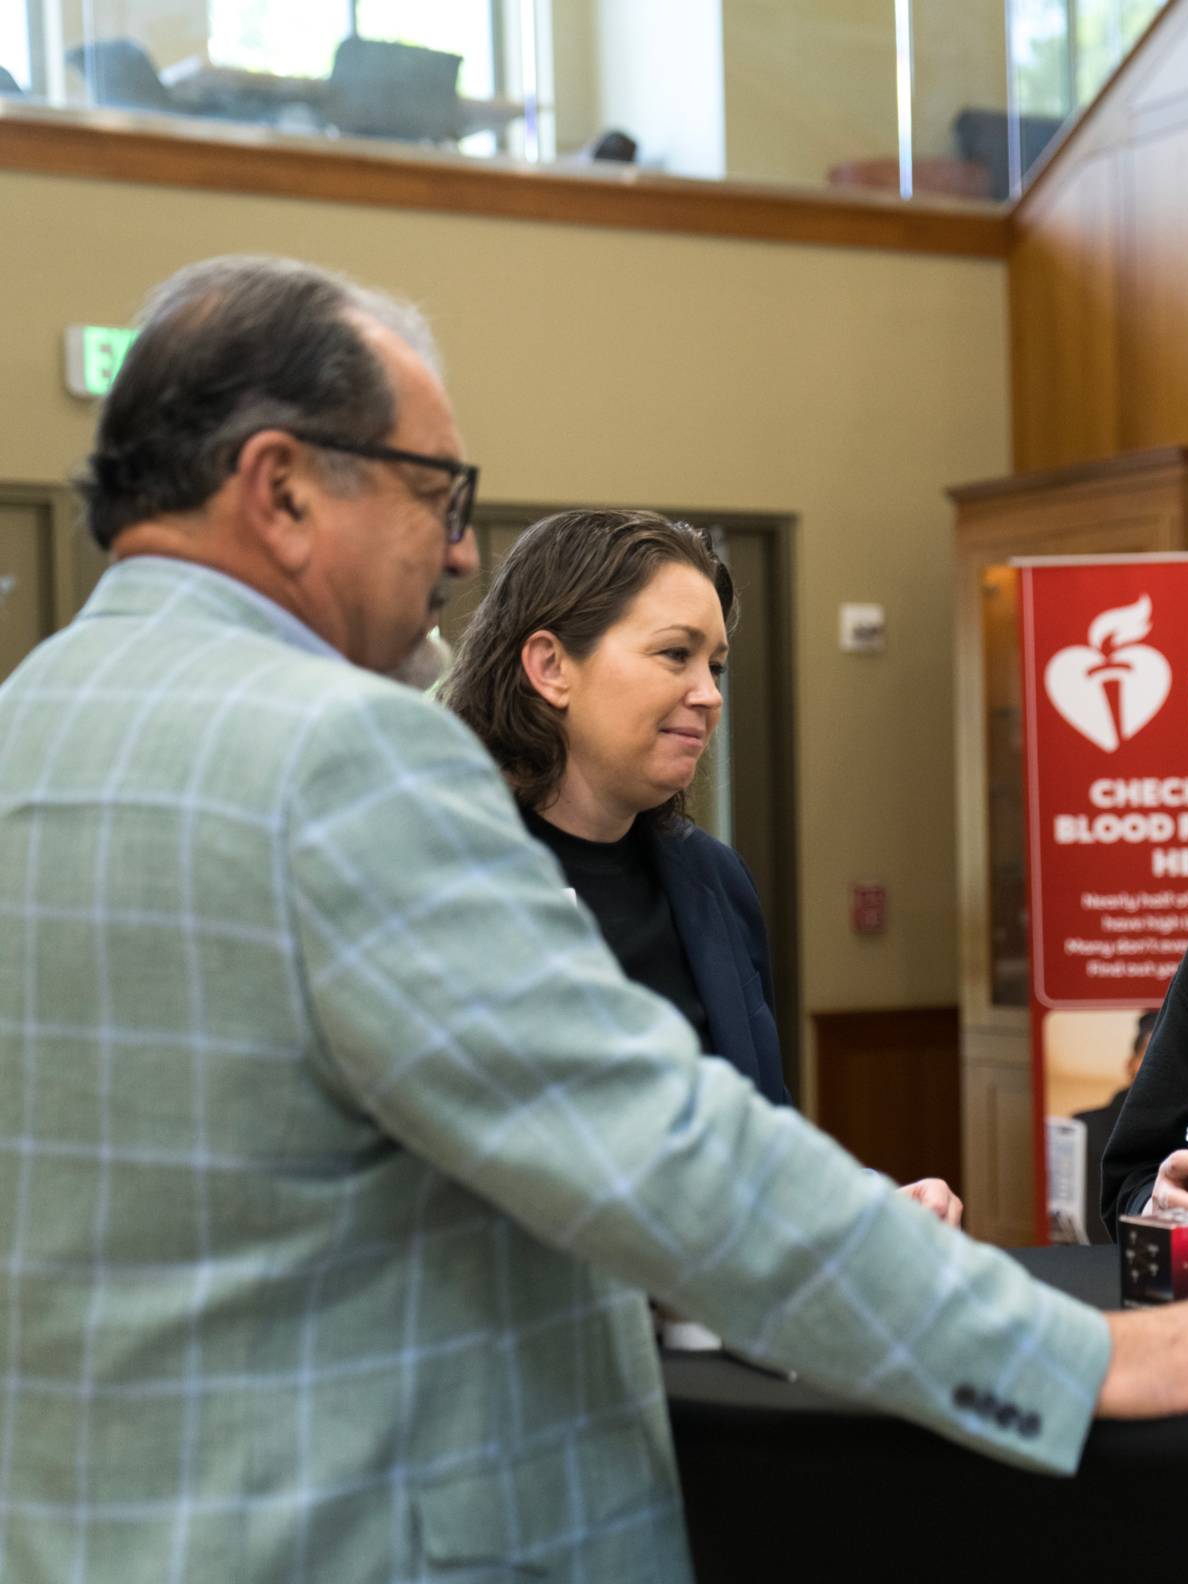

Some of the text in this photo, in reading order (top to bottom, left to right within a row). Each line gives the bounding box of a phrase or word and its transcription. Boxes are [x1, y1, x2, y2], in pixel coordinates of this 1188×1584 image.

[1055, 814, 1175, 844] BLOOD
[1081, 893, 1138, 912] Nearly
[1139, 891, 1173, 909] half
[1102, 915, 1144, 932] have
[1146, 914, 1179, 934] high
[1065, 938, 1114, 958] Many
[1086, 960, 1126, 977] Find
[1127, 961, 1156, 977] out
